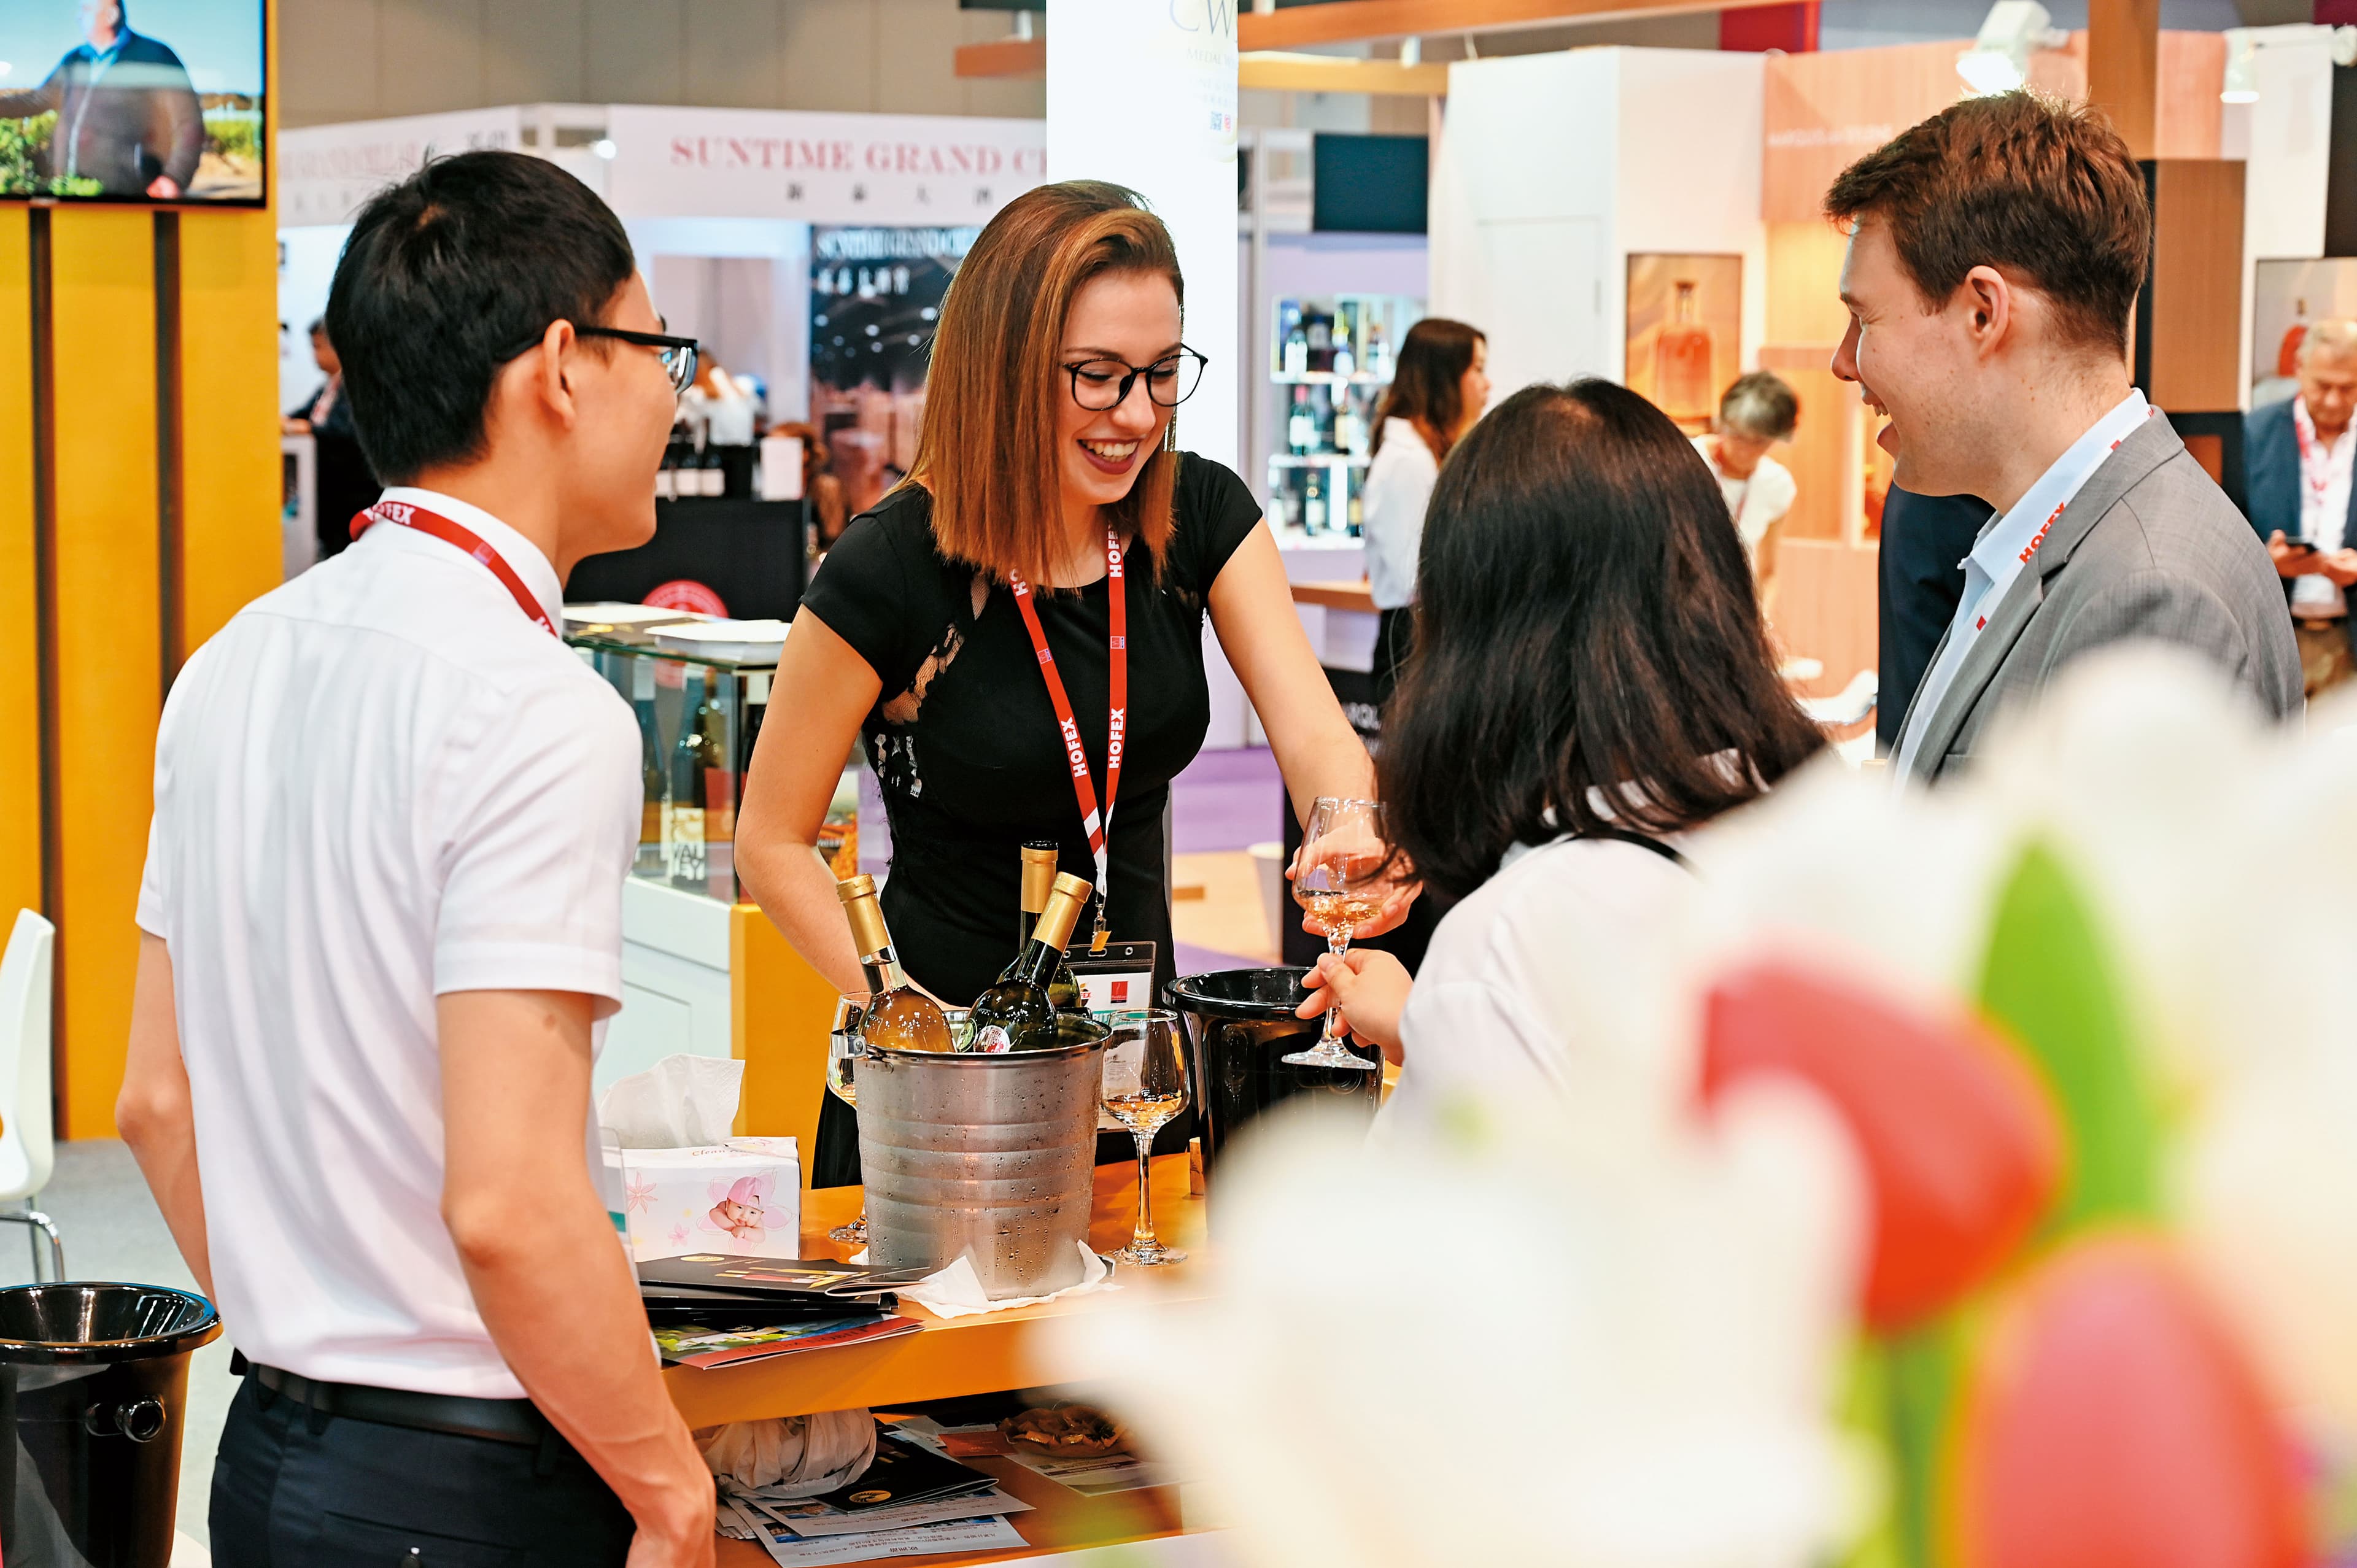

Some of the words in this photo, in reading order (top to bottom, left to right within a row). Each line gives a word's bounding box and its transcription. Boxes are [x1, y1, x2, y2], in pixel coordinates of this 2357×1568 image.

[670, 137, 854, 171] SUNTIME
[865, 143, 1002, 175] GRAND
[1108, 524, 1122, 577] HOFE
[1061, 716, 1087, 778] HOFEX
[1109, 708, 1124, 768] HOFEX
